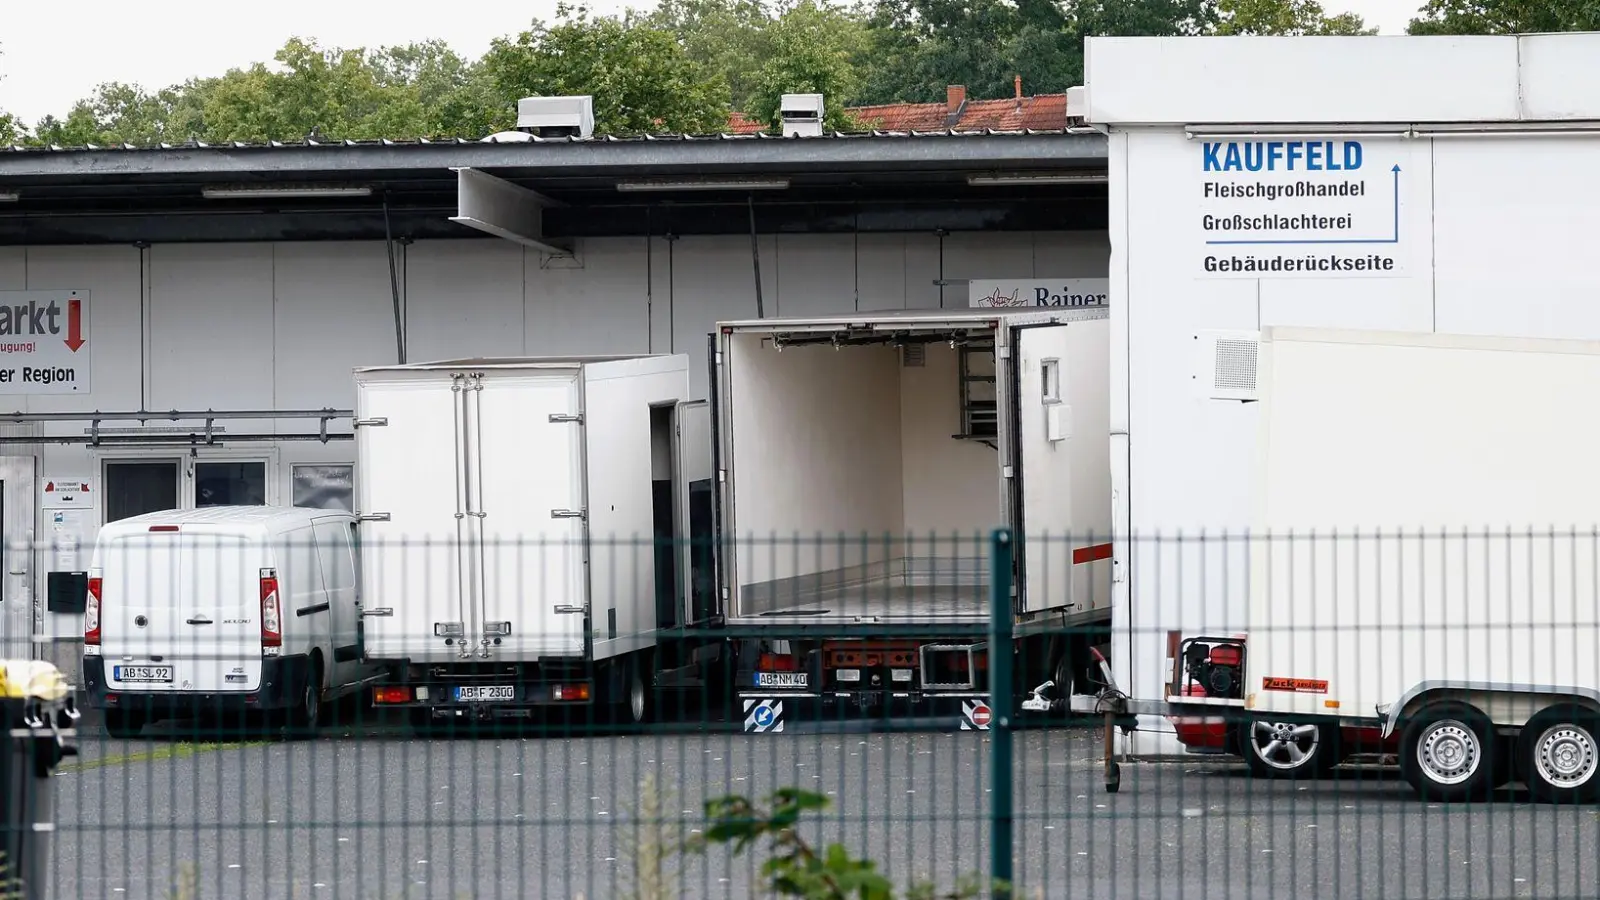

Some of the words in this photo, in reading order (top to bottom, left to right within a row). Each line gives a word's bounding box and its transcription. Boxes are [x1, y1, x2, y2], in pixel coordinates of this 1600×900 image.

[1203, 141, 1363, 172] KAUFFELD
[1204, 181, 1365, 200] Fleischgroßhandel
[1203, 214, 1352, 230] Großschlachterei
[1204, 255, 1394, 272] Gebäuderückseite
[1034, 286, 1106, 307] Rainer
[23, 367, 75, 384] Region
[123, 668, 136, 678] AB
[142, 668, 154, 678] SL
[155, 668, 168, 678] 92
[760, 674, 773, 684] AB
[779, 674, 792, 684] NM
[794, 674, 806, 684] 40
[460, 687, 474, 698] AB
[479, 687, 486, 698] F
[489, 686, 513, 698] 2300
